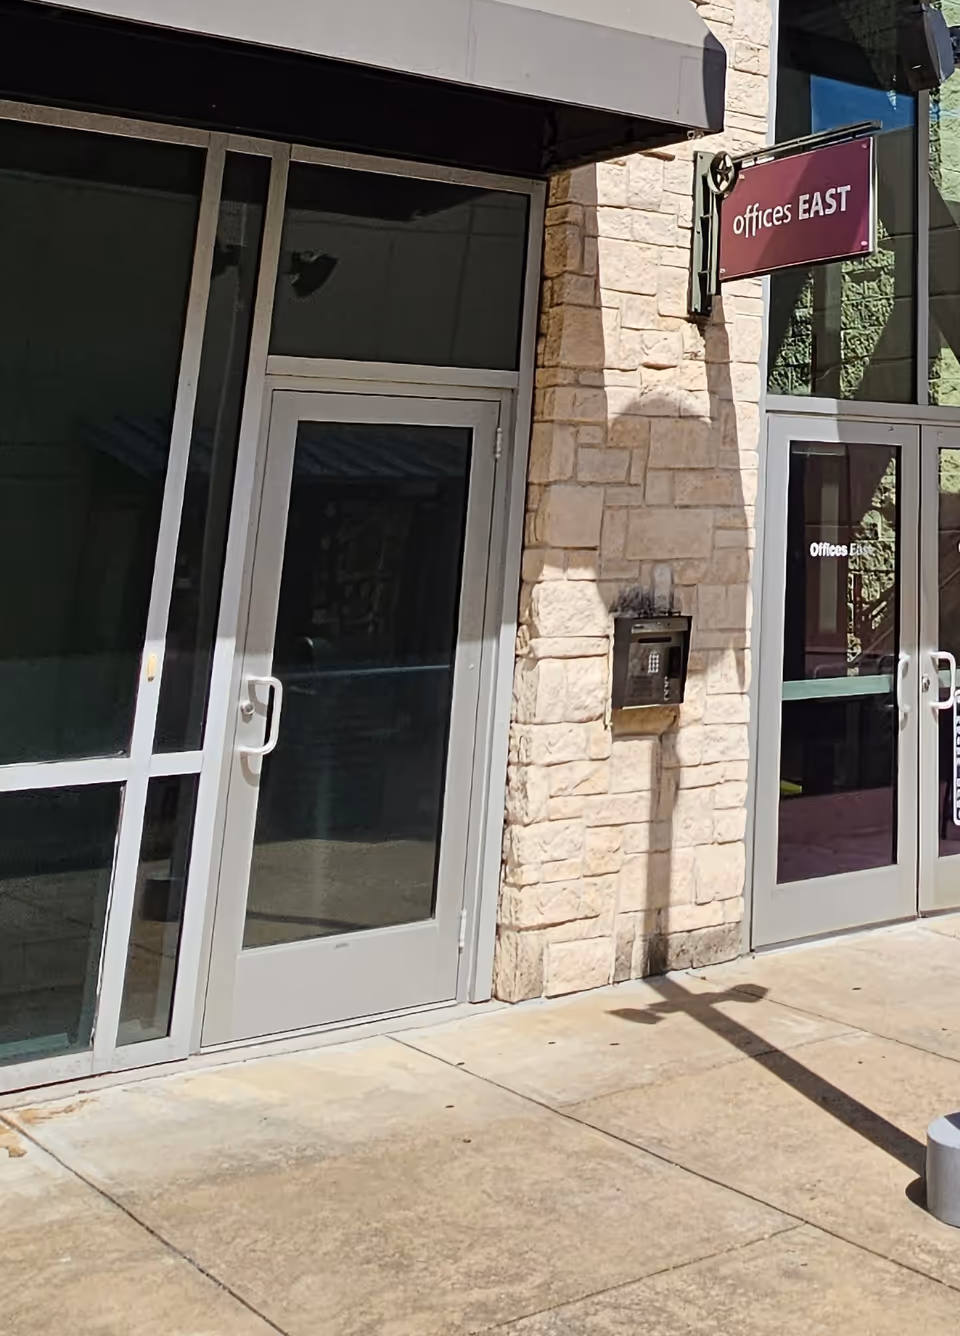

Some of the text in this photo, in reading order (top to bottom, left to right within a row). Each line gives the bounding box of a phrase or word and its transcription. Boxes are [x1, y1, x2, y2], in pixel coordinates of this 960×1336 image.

[733, 184, 851, 238] offices EAST
[810, 542, 848, 557] Offices
